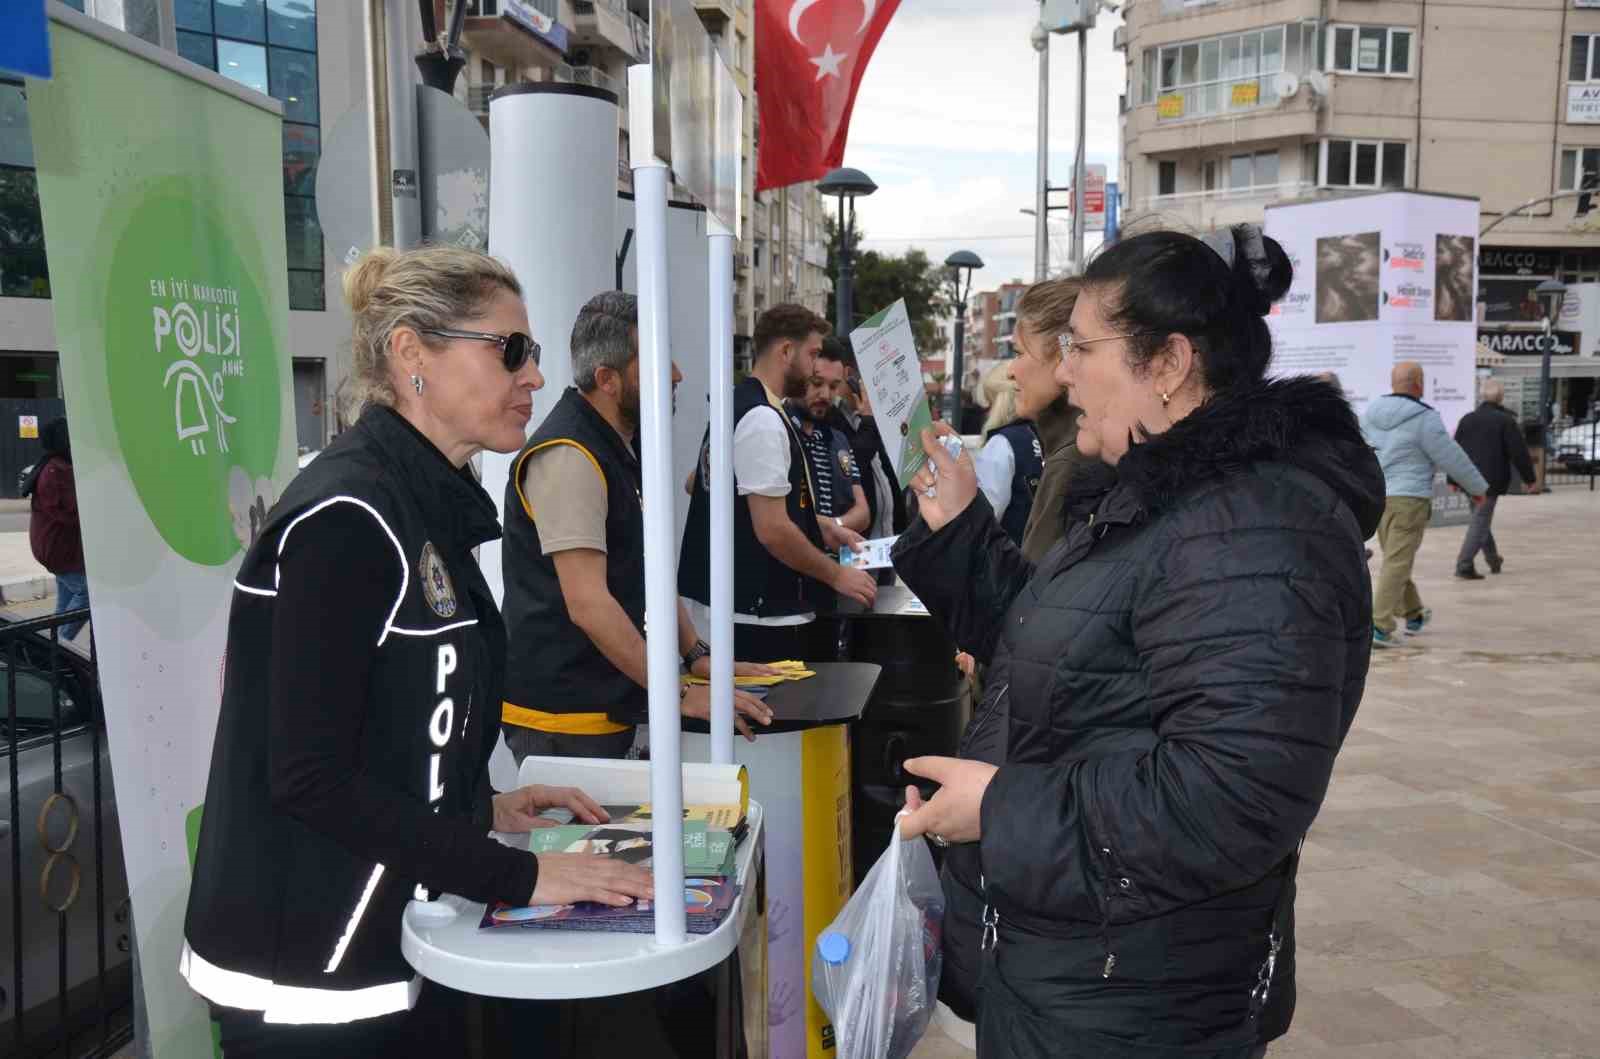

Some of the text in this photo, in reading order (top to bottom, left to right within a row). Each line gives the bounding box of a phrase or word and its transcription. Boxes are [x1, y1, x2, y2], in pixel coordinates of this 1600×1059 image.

[150, 279, 166, 297] EN
[153, 301, 240, 357] POLİSİ
[222, 359, 244, 377] ANNE
